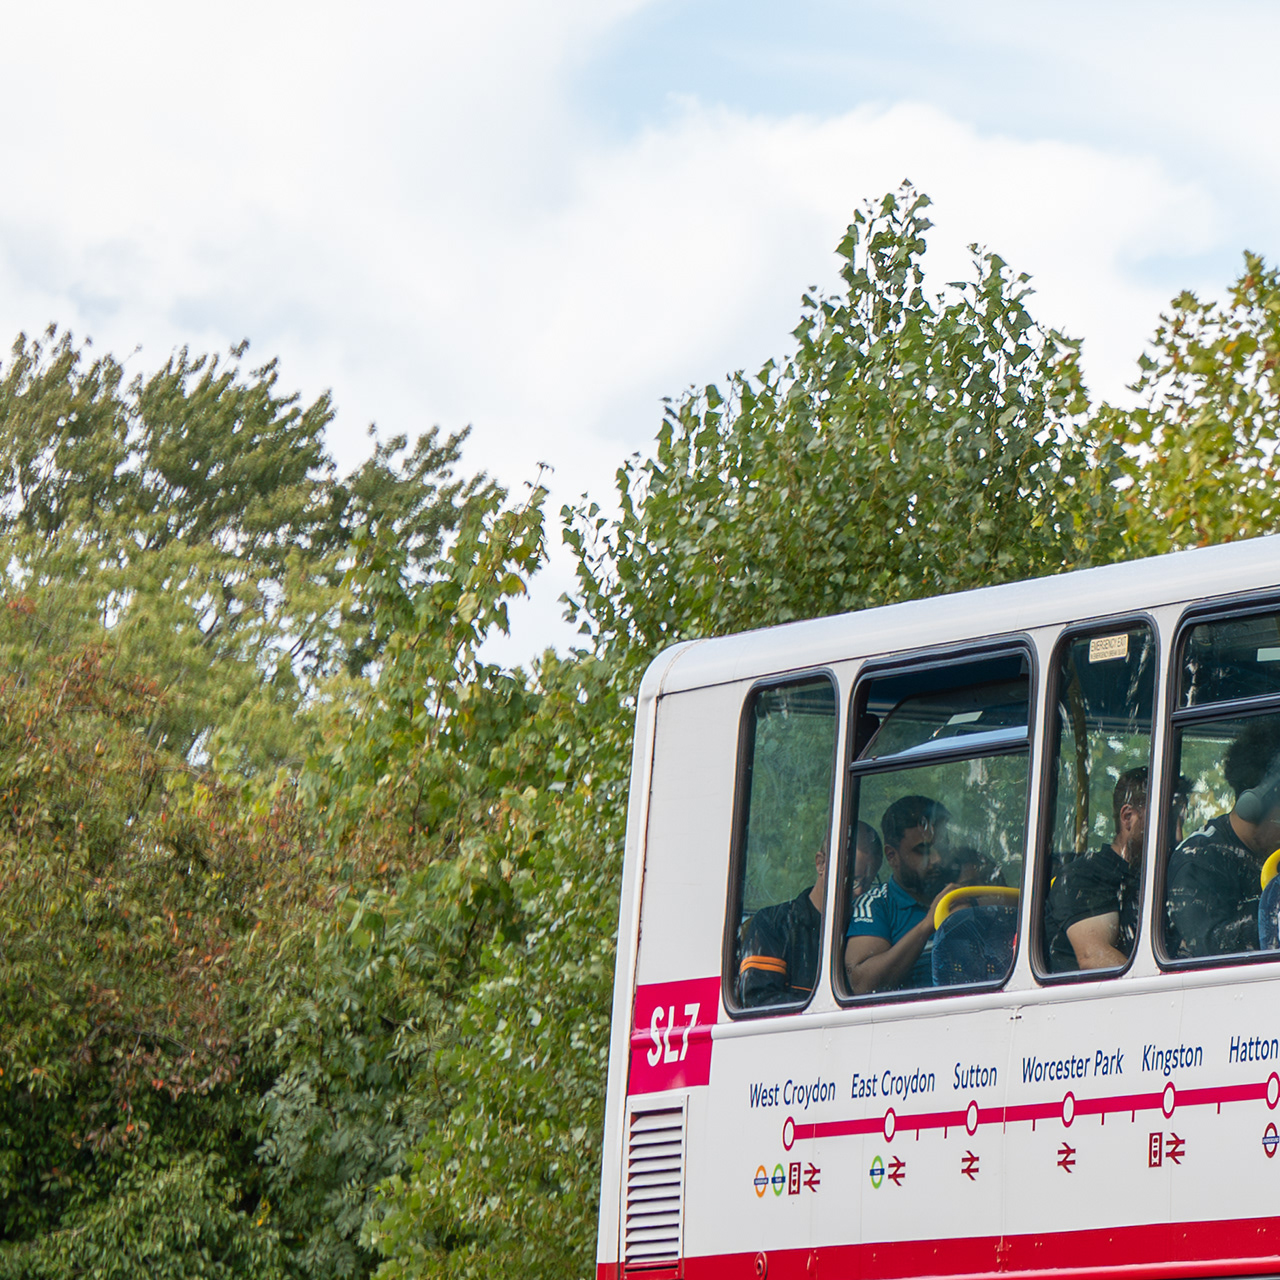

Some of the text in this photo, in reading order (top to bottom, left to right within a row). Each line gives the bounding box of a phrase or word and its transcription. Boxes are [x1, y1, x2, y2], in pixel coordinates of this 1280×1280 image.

[647, 1002, 701, 1067] SL7
[1229, 1036, 1279, 1063] Hatton
[1022, 1048, 1123, 1083] Worcester Park
[1142, 1044, 1203, 1076] Kingston
[851, 1067, 935, 1100] East Croydon
[953, 1063, 997, 1090] Sutton
[749, 1079, 836, 1109] West Croydon
